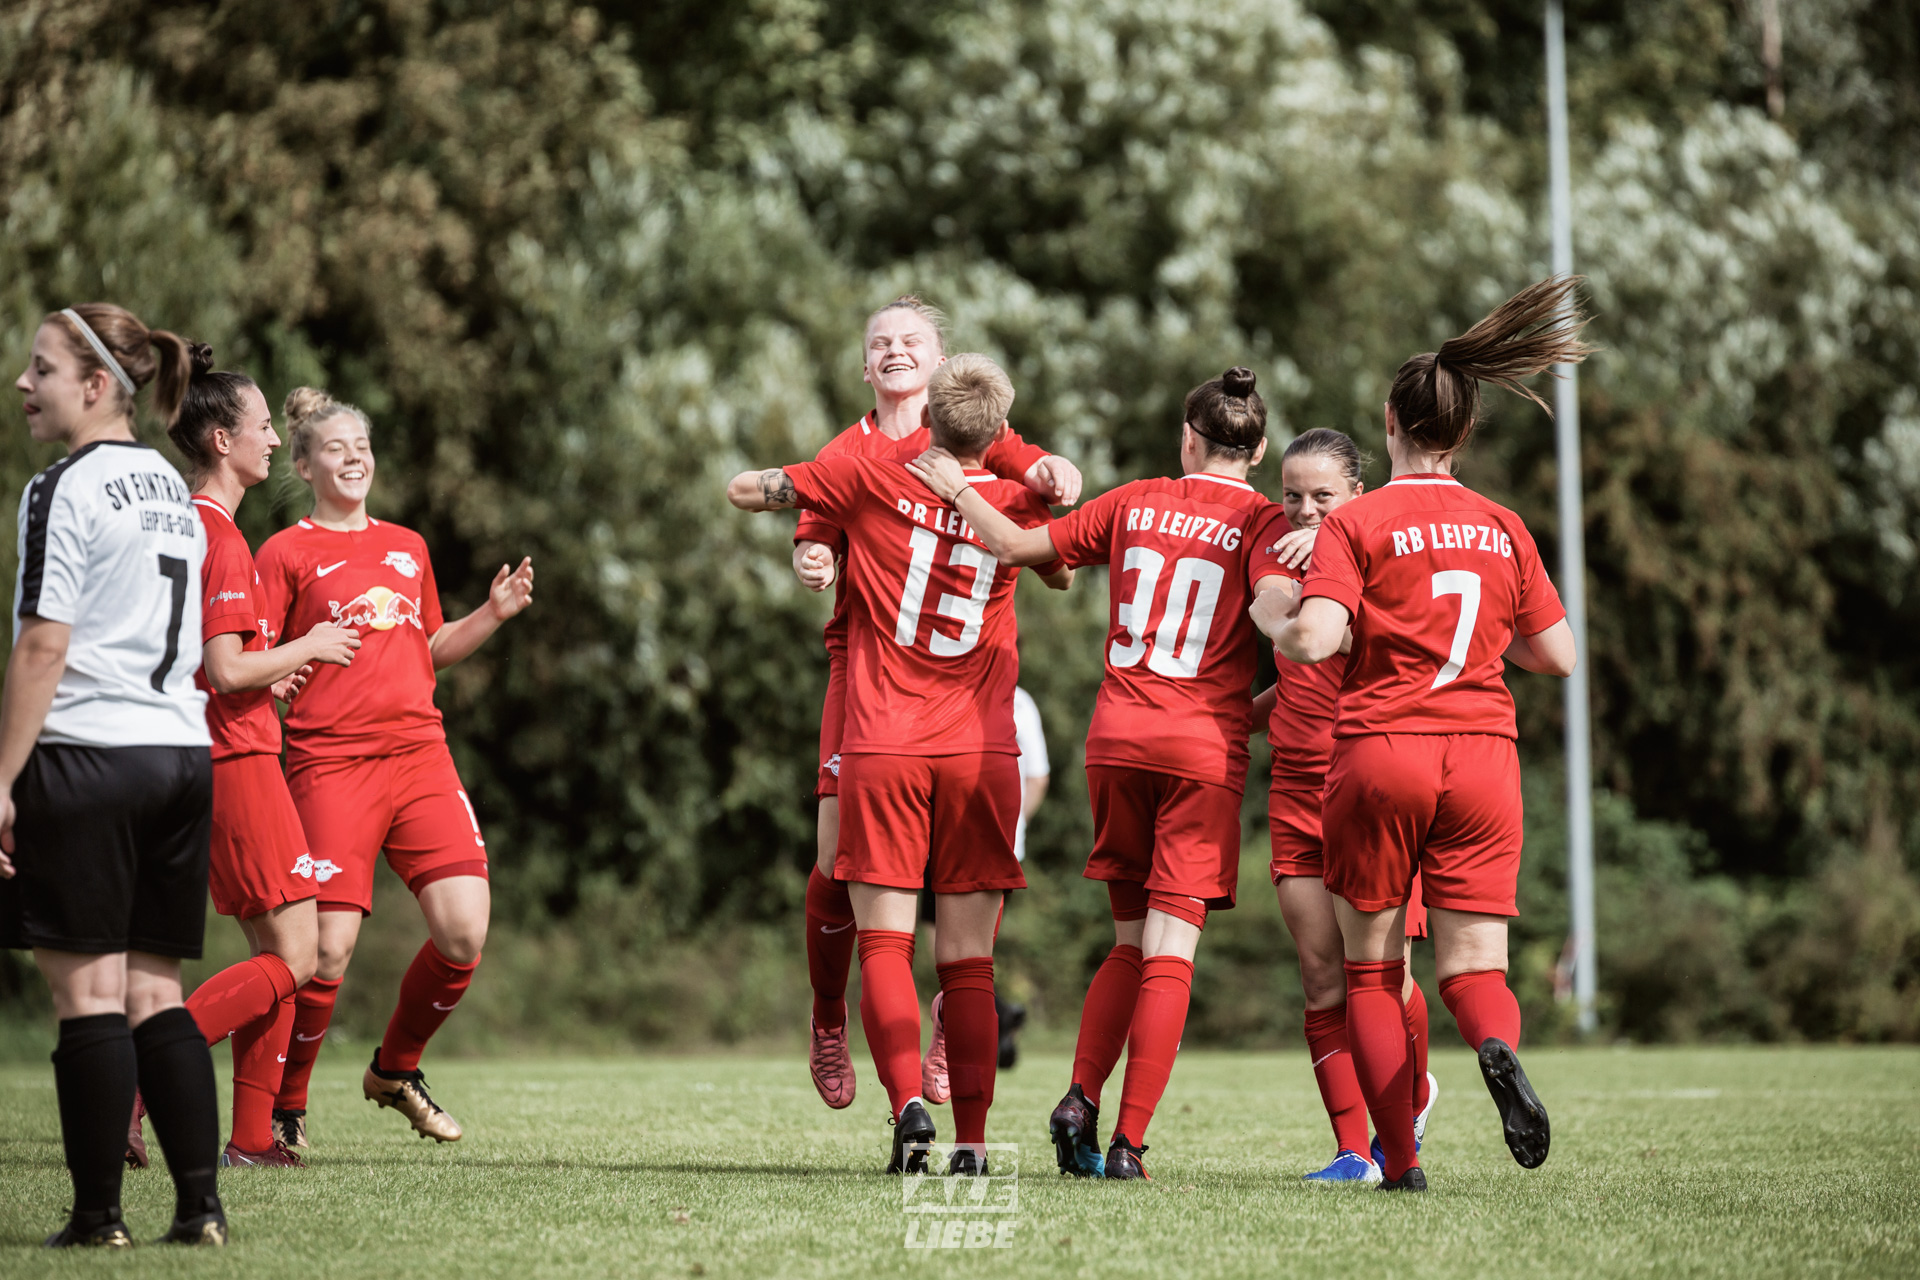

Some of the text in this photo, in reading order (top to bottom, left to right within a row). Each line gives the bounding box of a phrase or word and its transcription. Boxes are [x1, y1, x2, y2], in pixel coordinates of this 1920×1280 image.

[105, 478, 131, 510] SV
[1127, 507, 1242, 551] RB LEIPZIG
[1392, 523, 1512, 558] RB LEIPZIG
[151, 553, 188, 694] 7
[895, 526, 999, 657] 13
[1109, 546, 1225, 678] 30
[1430, 569, 1481, 690] 7
